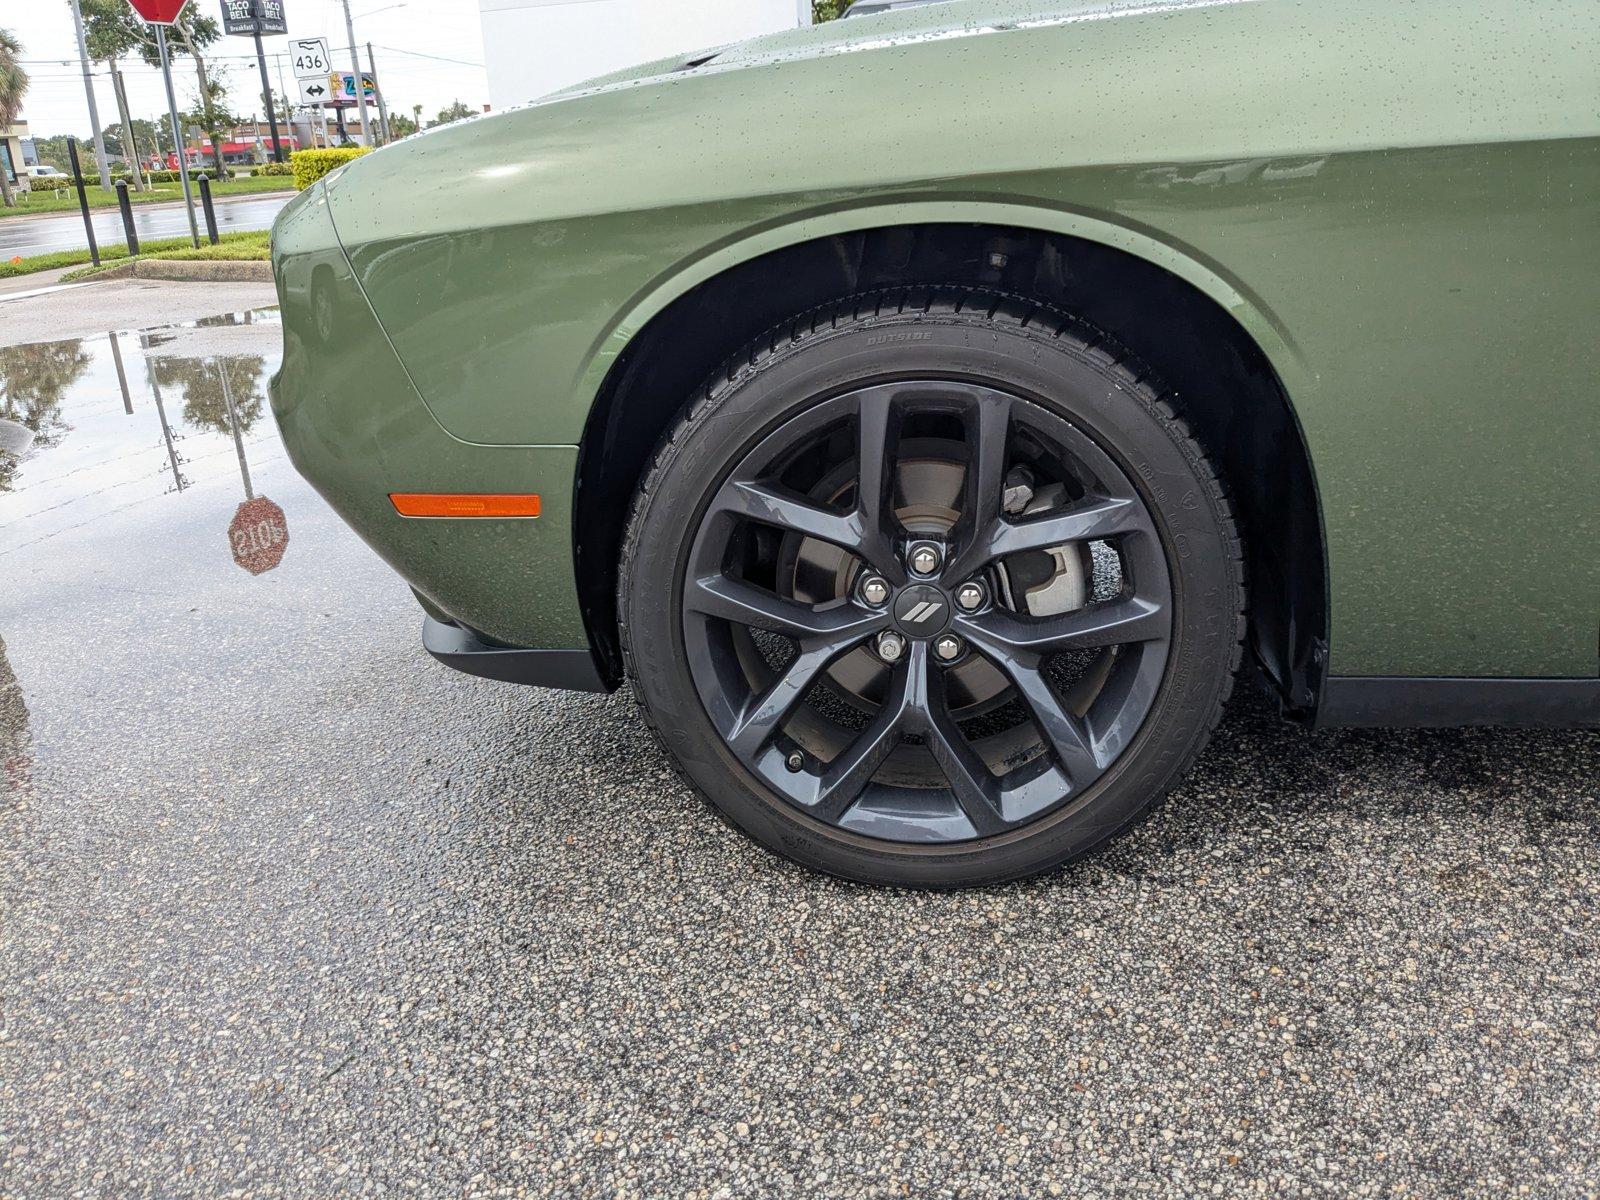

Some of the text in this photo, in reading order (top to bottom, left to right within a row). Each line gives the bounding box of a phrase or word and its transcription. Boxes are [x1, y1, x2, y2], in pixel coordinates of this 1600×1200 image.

[227, 1, 249, 11] TACO
[263, 2, 280, 11] TACO
[230, 10, 251, 20] BELL
[265, 10, 281, 20] BELL
[230, 24, 254, 32] Breakfast
[296, 55, 322, 70] 436
[866, 331, 932, 346] OUTSIDE
